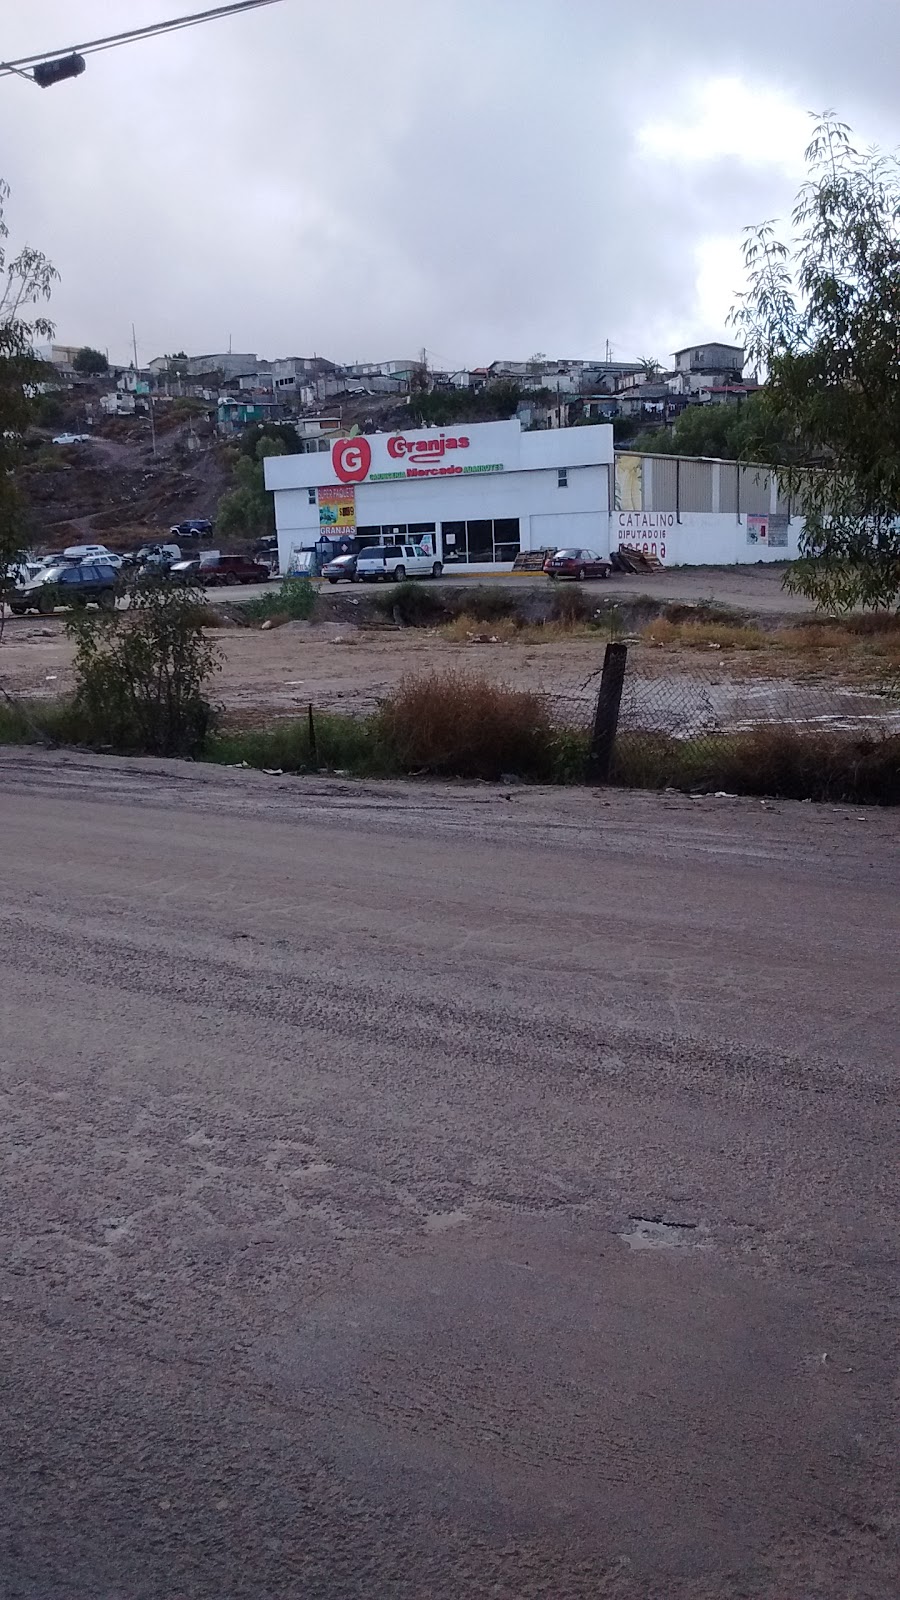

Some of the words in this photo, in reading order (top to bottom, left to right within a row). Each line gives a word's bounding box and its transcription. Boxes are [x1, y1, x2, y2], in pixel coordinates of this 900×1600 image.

[388, 434, 470, 460] Granjas
[341, 447, 362, 472] G
[406, 465, 463, 478] Mercado
[618, 513, 674, 526] CATALINO
[320, 525, 356, 534] GRANJAS
[618, 530, 658, 539] DIPUTADO
